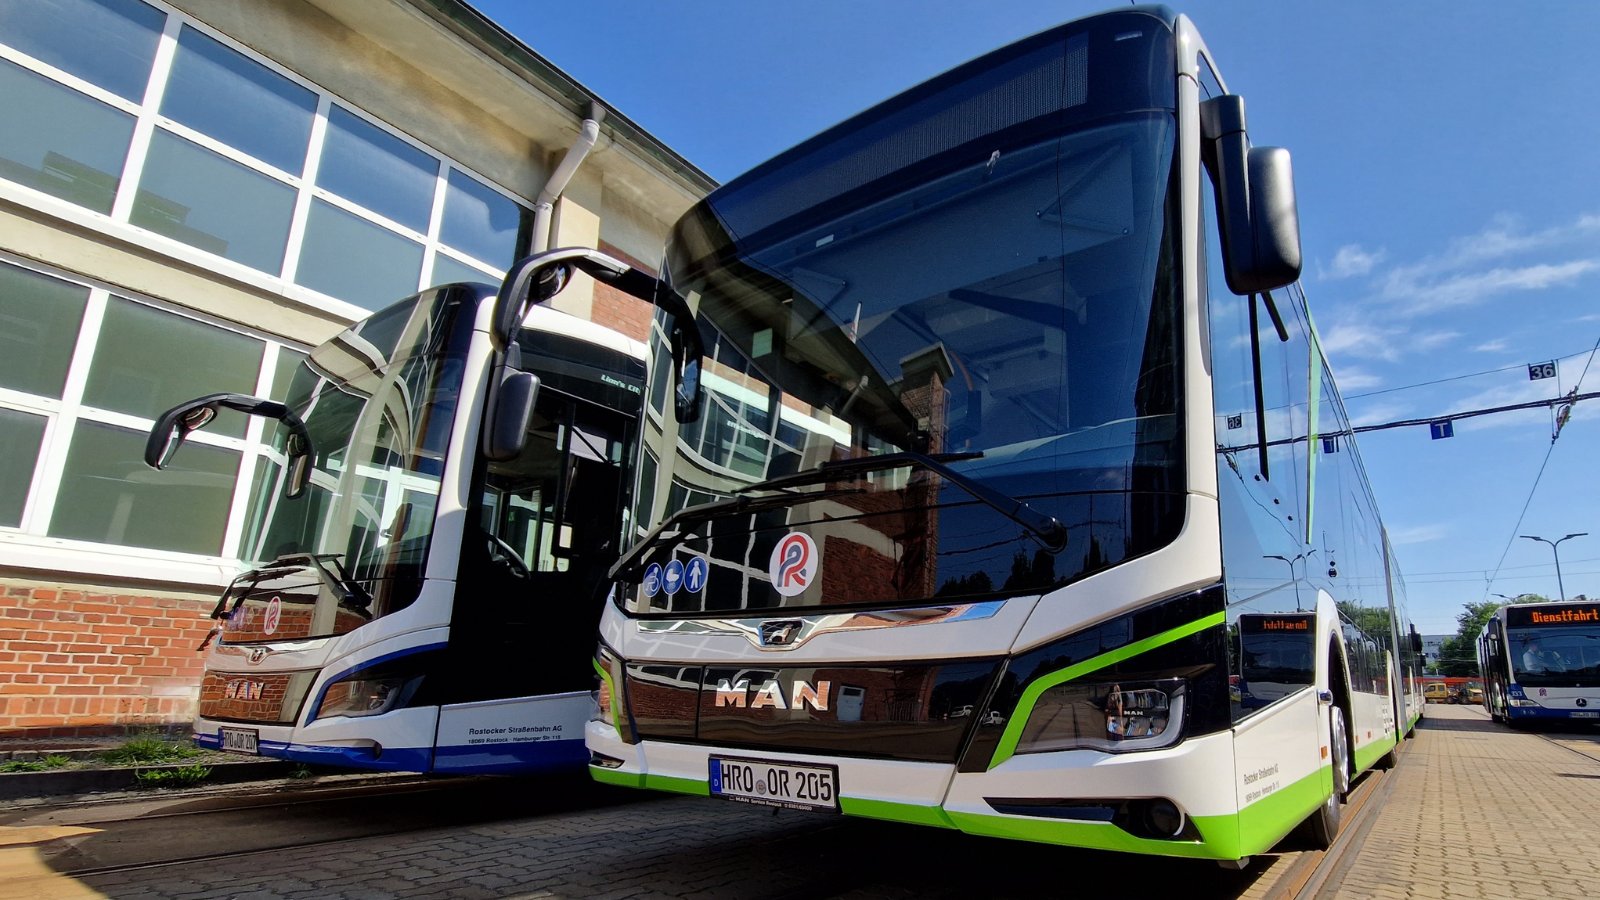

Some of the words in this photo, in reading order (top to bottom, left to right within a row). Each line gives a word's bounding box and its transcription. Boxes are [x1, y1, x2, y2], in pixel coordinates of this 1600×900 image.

[1531, 364, 1554, 379] 36
[1435, 423, 1449, 438] T
[1532, 609, 1599, 623] Dienstfahrt
[224, 681, 265, 700] MAN
[715, 678, 832, 711] MAN
[468, 727, 506, 736] Rostocker
[508, 725, 551, 734] Straßenbahn
[721, 763, 754, 793] HRO
[767, 768, 791, 798] OR
[795, 771, 832, 802] 205
